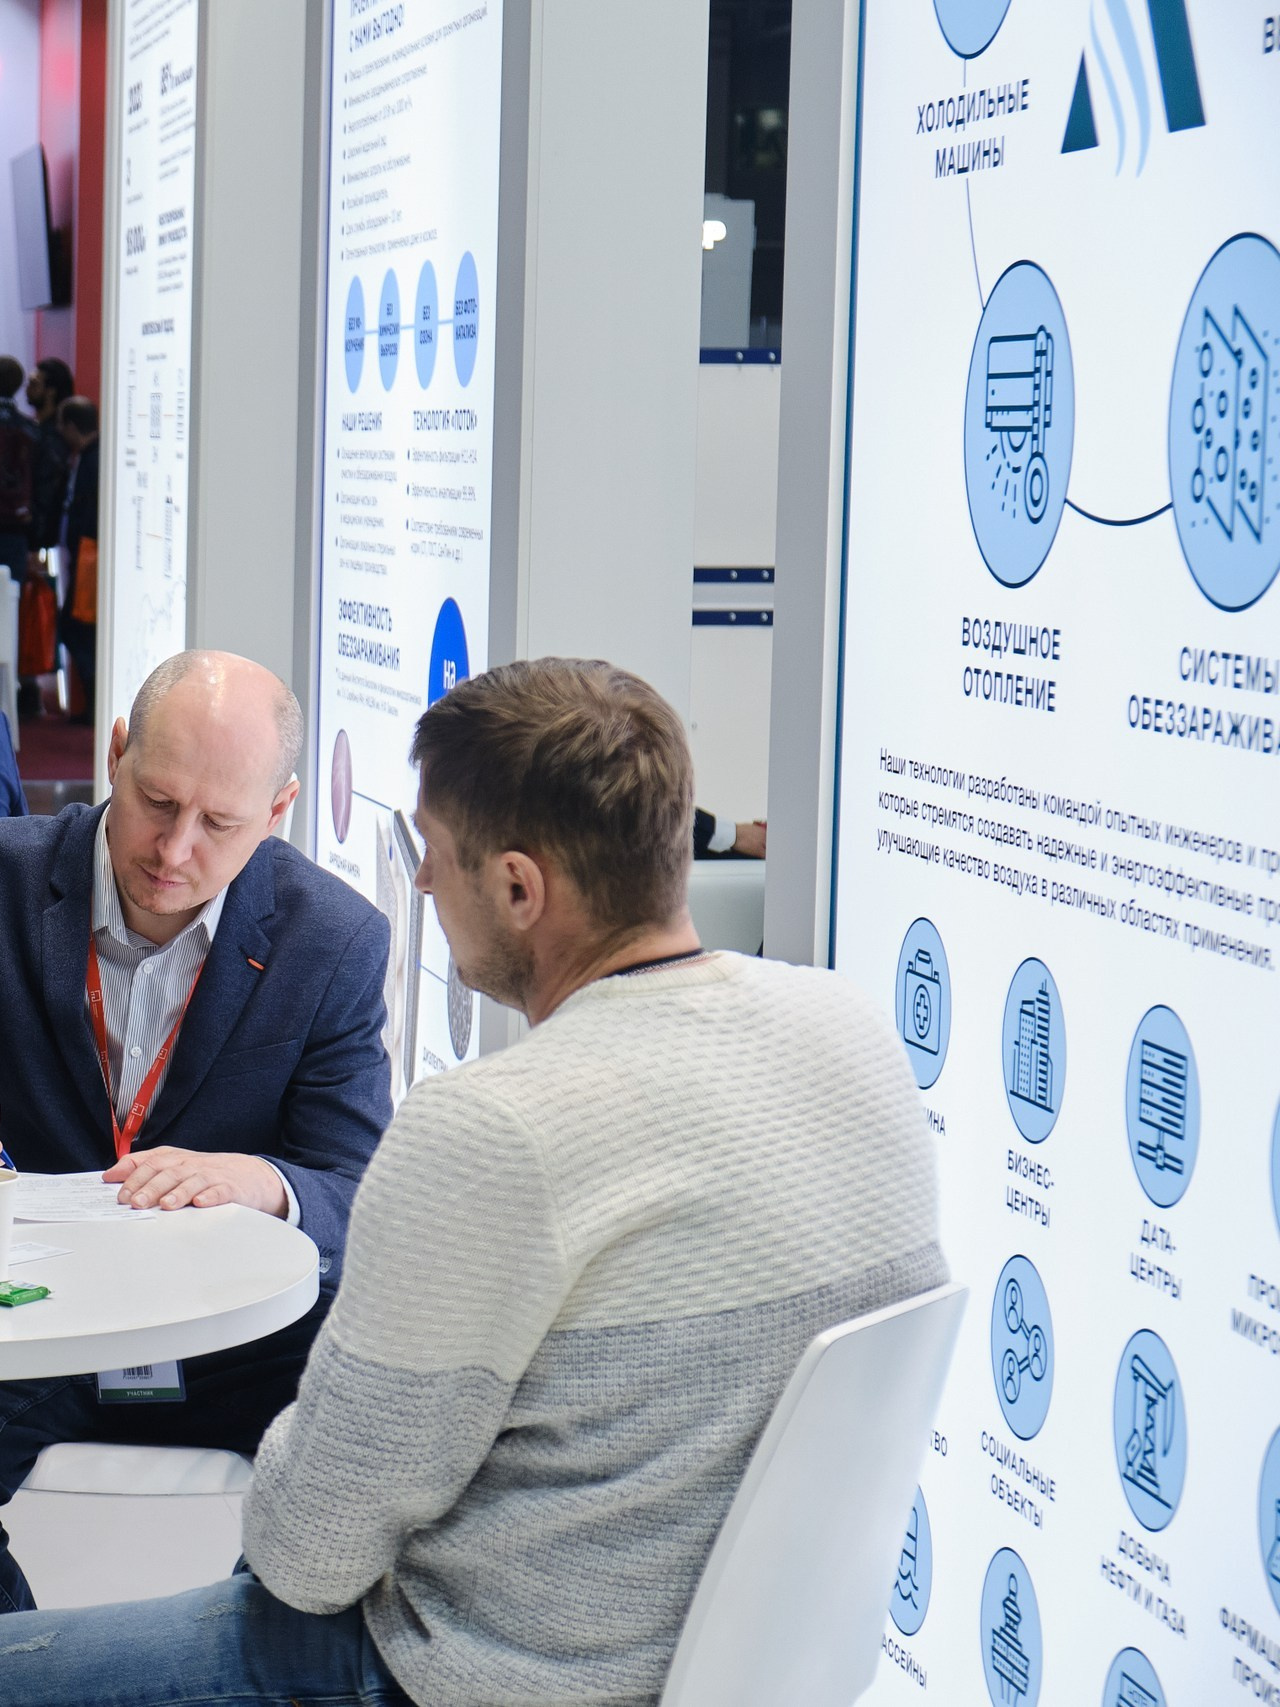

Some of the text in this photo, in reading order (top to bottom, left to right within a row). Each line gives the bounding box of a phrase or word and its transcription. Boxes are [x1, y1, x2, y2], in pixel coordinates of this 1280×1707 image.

[1263, 15, 1280, 54] В
[916, 78, 1030, 134] ХОЛОДИЛЬНЫЕ
[935, 135, 1005, 178] МАШИНЫ
[413, 408, 478, 431] ТЕХНОЛОГИЯ «ПОТОК»
[338, 598, 393, 633] ЭФФЕКТИВНОСТЬ
[962, 616, 1061, 660] ВОЗДУШНОЕ
[337, 633, 401, 672] ОБЕЗЗАРАЖИВАНИЯ
[1180, 646, 1280, 695] СИСТЕМЫ
[963, 666, 1056, 712] ОТОПЛЕНИЕ
[880, 747, 906, 776] Наши
[909, 760, 965, 791] технологии
[968, 775, 1040, 810] разработаны
[1044, 793, 1102, 828] командой
[1106, 809, 1162, 842] опытных
[1166, 823, 1242, 866] инженеров
[1247, 845, 1256, 867] и
[878, 791, 919, 820] которые
[922, 802, 974, 833] стремятся
[977, 818, 1033, 850] создавать
[1037, 834, 1097, 869] надежные
[1101, 852, 1108, 872] и
[1112, 855, 1254, 915] энергоэффективные
[877, 828, 1275, 971] улучшающие качество воздуха в различных областях применения.
[1007, 1149, 1054, 1189] БИЗНЕС-
[1006, 1186, 1051, 1228] ЦЕНТРЫ
[1140, 1219, 1176, 1255] ДАТА-
[1130, 1252, 1183, 1301] ЦЕНТРЫ
[126, 1390, 154, 1398] УЧАСТНИК
[981, 1431, 1056, 1502] СОЦИАЛЬНЫЕ
[990, 1473, 1043, 1530] ОБЪЕКТЫ
[1118, 1530, 1172, 1588] ДОБЫЧА
[1100, 1555, 1188, 1641] НЕФТИ И ГАЗА
[881, 1633, 927, 1690] АССЕЙНЫ
